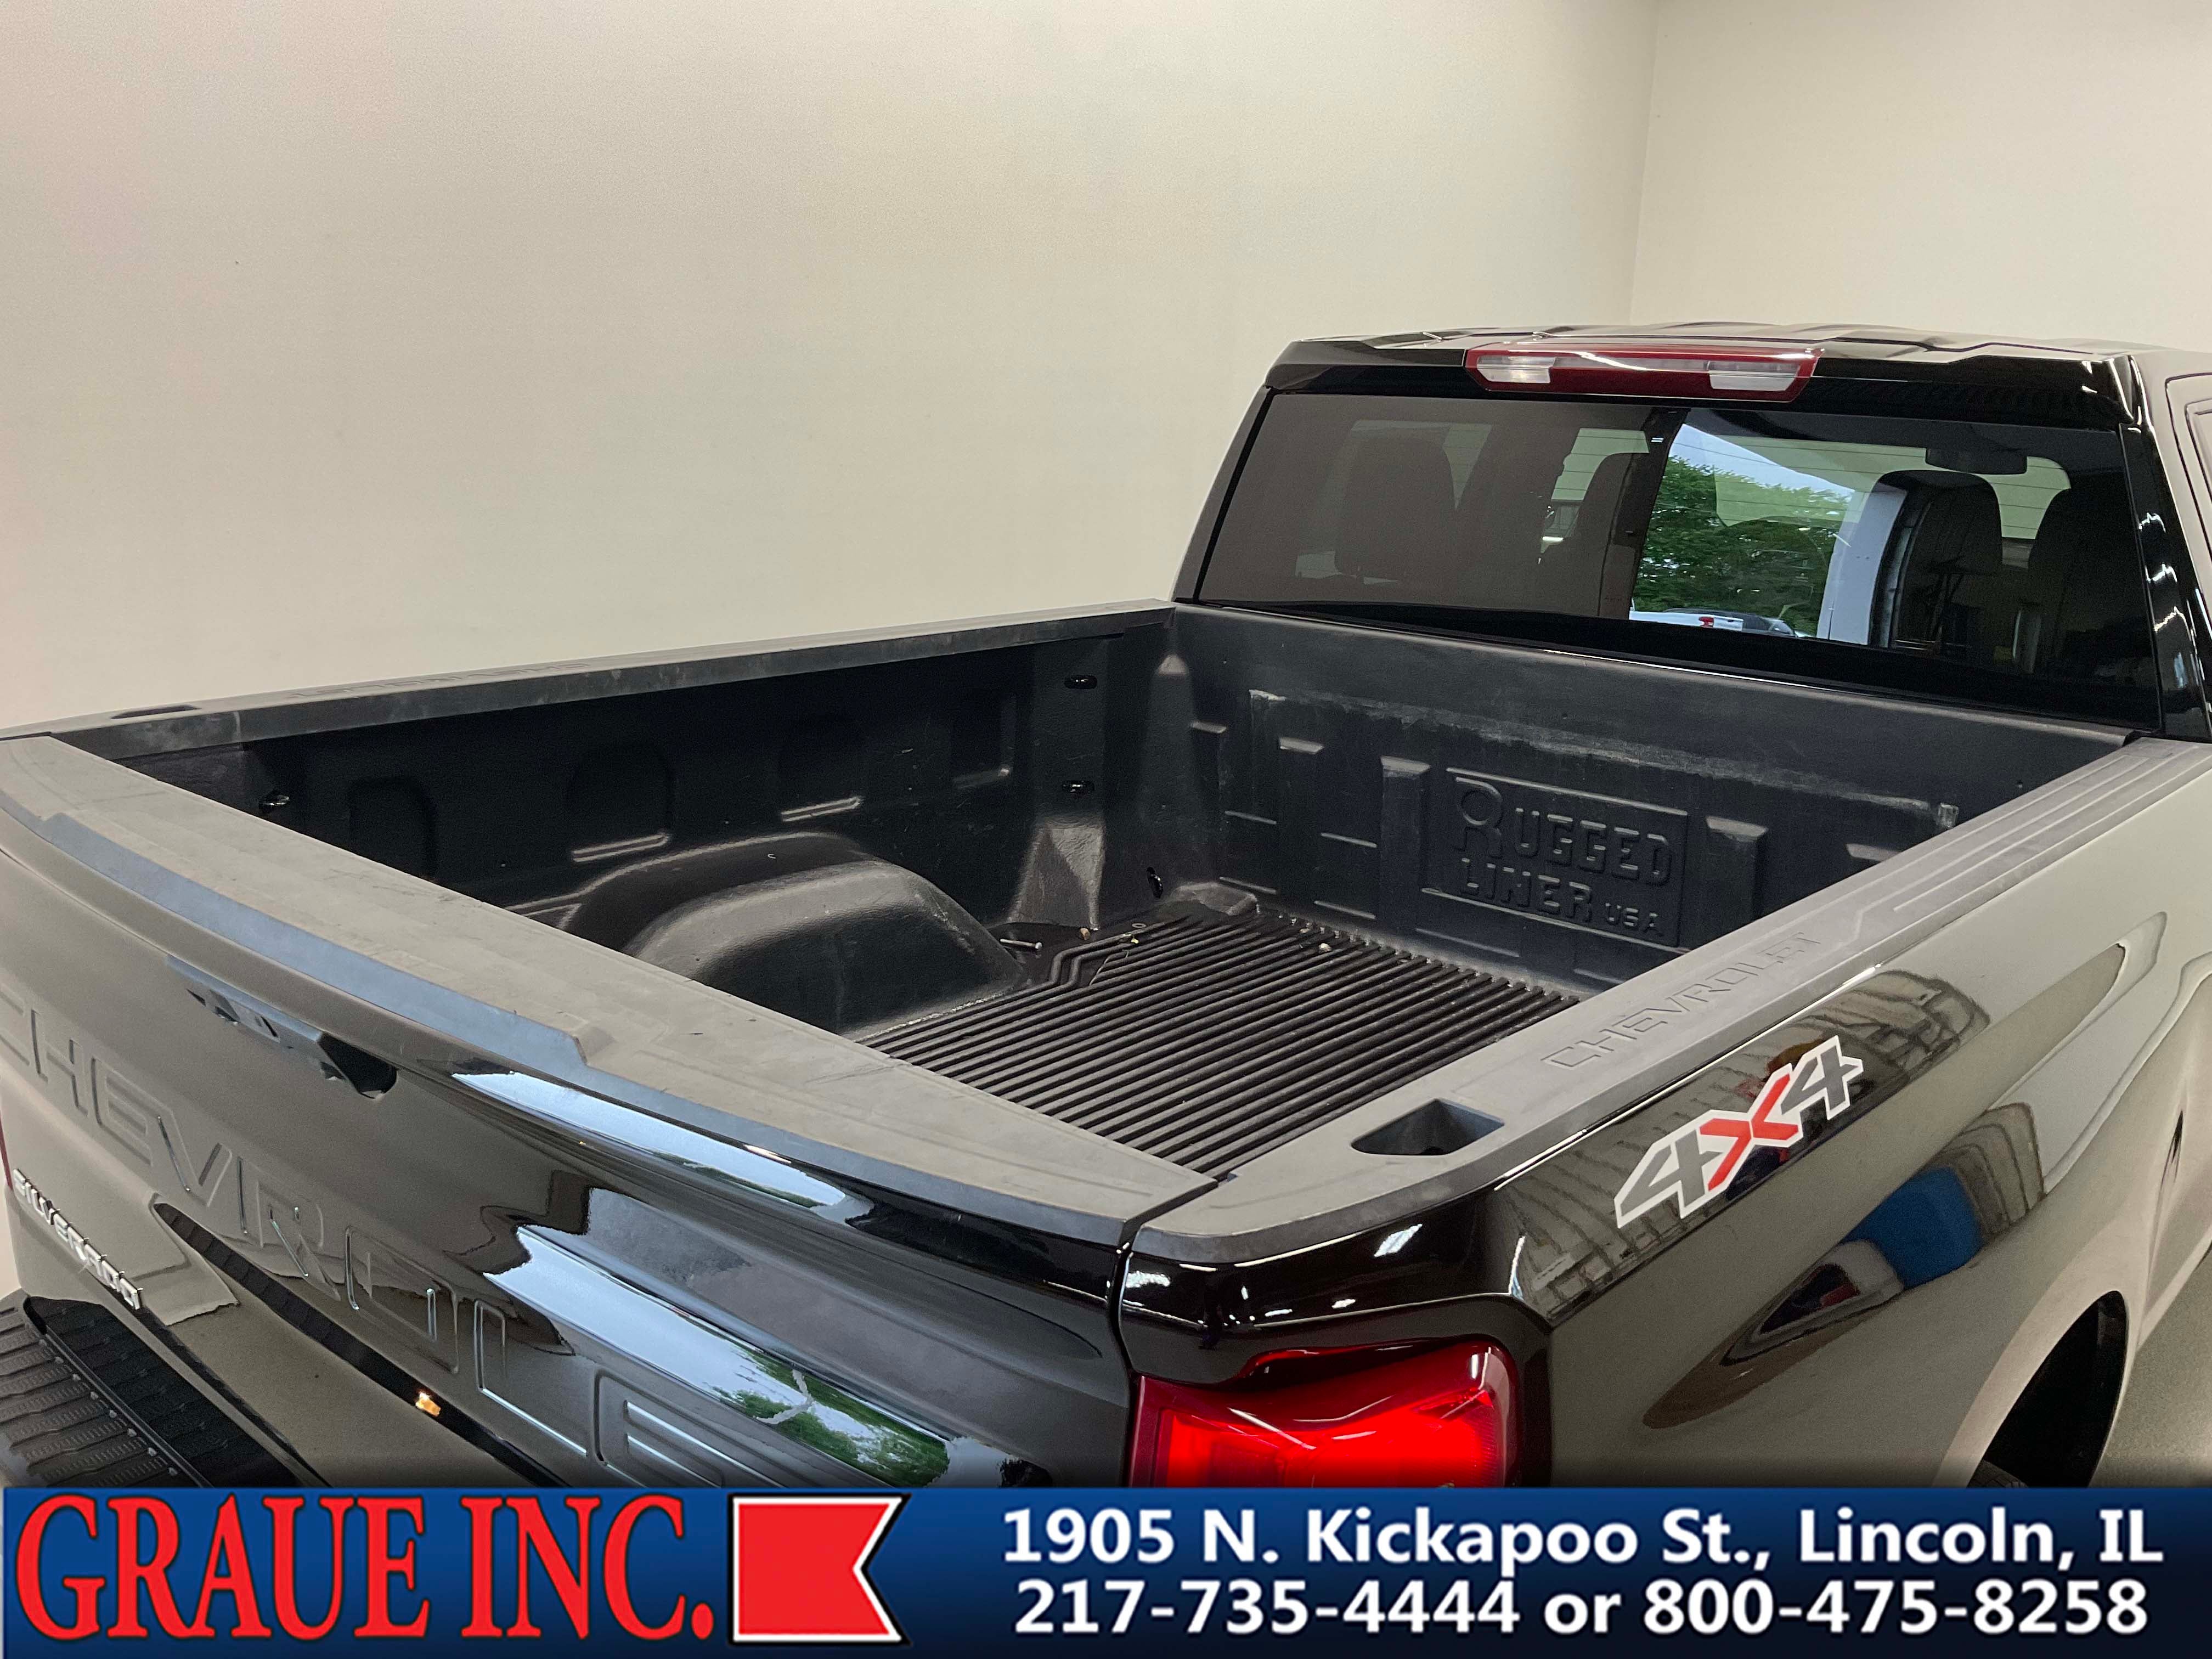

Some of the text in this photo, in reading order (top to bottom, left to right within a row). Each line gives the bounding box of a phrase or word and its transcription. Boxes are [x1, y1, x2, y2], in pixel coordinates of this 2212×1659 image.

[1453, 776, 1672, 887] RUGGED
[1460, 857, 1593, 923] LINER
[1540, 932, 1821, 1069] CHEVROLET
[0, 981, 817, 1487] HEVROLE
